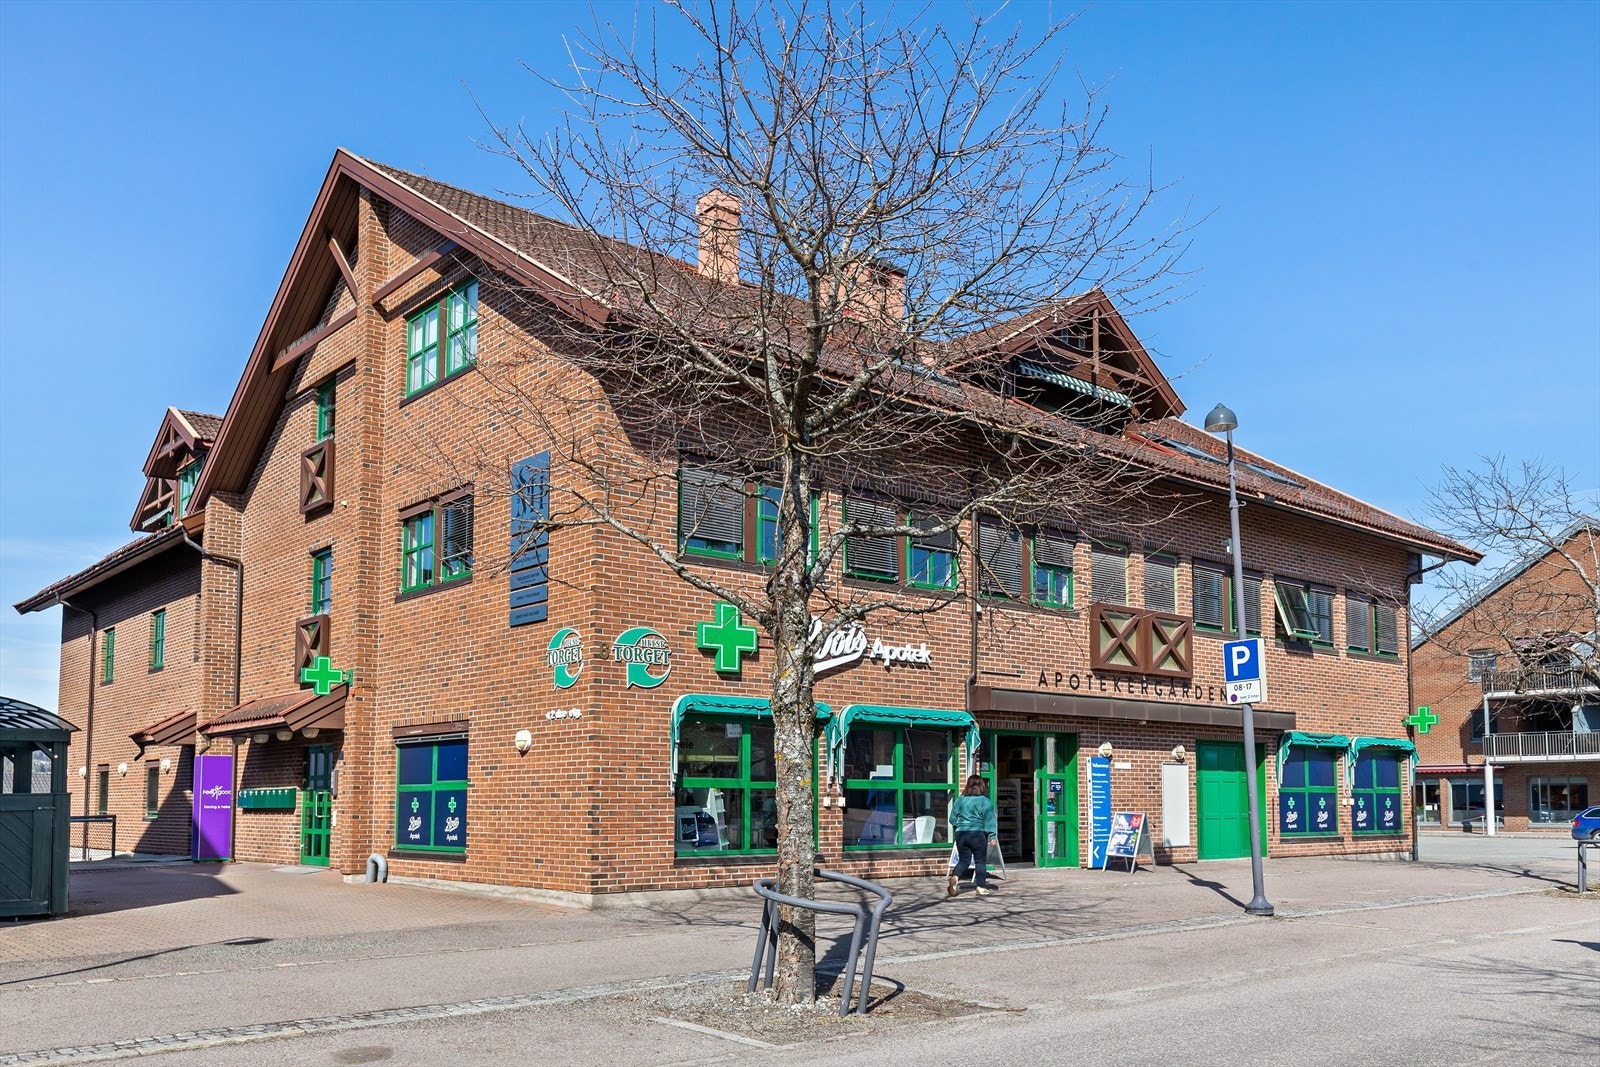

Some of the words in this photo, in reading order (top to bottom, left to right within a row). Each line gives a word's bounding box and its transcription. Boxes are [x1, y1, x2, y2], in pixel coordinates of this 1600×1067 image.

[639, 638, 667, 649] HELSE
[869, 638, 932, 666] Apotek
[547, 647, 584, 666] TORGET
[613, 645, 672, 665] TORGET
[1231, 645, 1250, 677] P
[1233, 682, 1252, 692] 08-17
